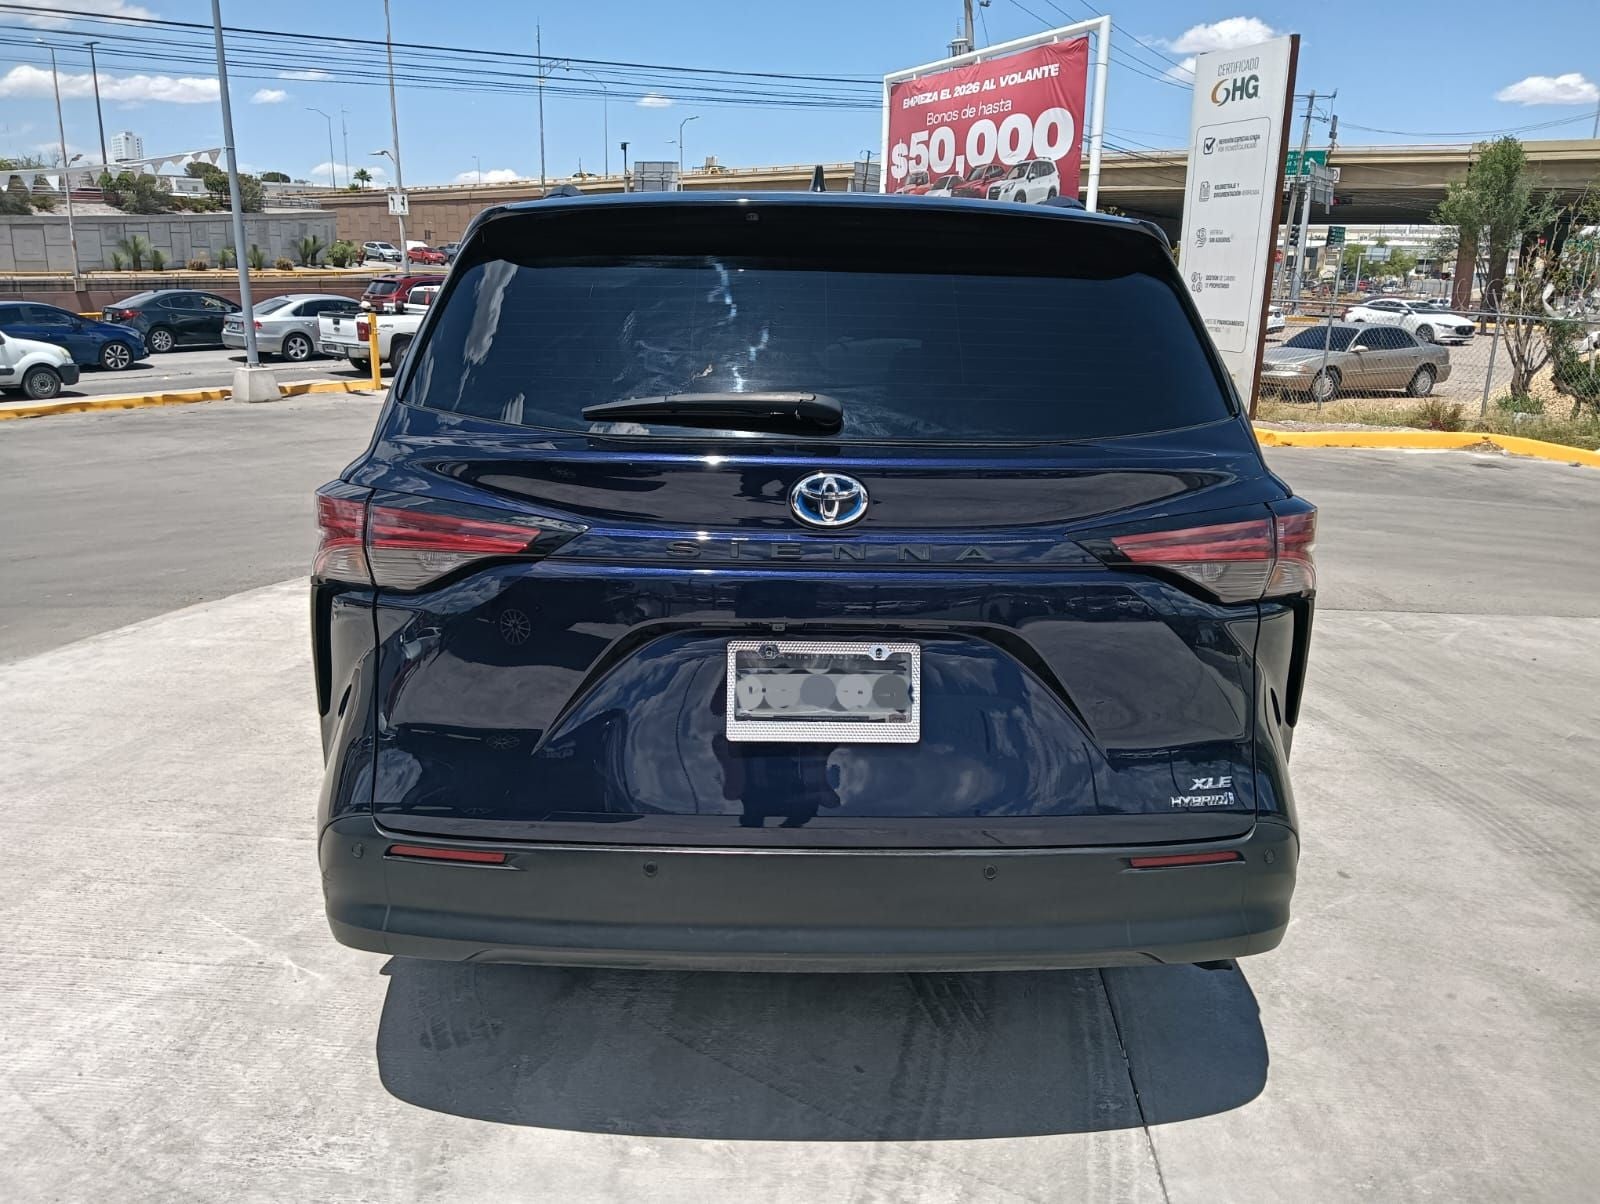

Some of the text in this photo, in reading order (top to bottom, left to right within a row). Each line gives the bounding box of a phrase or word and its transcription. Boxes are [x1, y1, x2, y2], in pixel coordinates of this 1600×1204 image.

[1217, 56, 1260, 77] CERTIFICADO
[940, 90, 952, 101] EL
[953, 82, 980, 98] 2026
[981, 79, 997, 91] AL
[1000, 63, 1060, 88] VOLANTE
[926, 98, 1012, 126] Bonos de hasta
[890, 106, 1075, 184] $50,000
[666, 540, 994, 562] SIENNA
[1189, 775, 1233, 791] XLE
[1170, 794, 1225, 808] HYBRID
